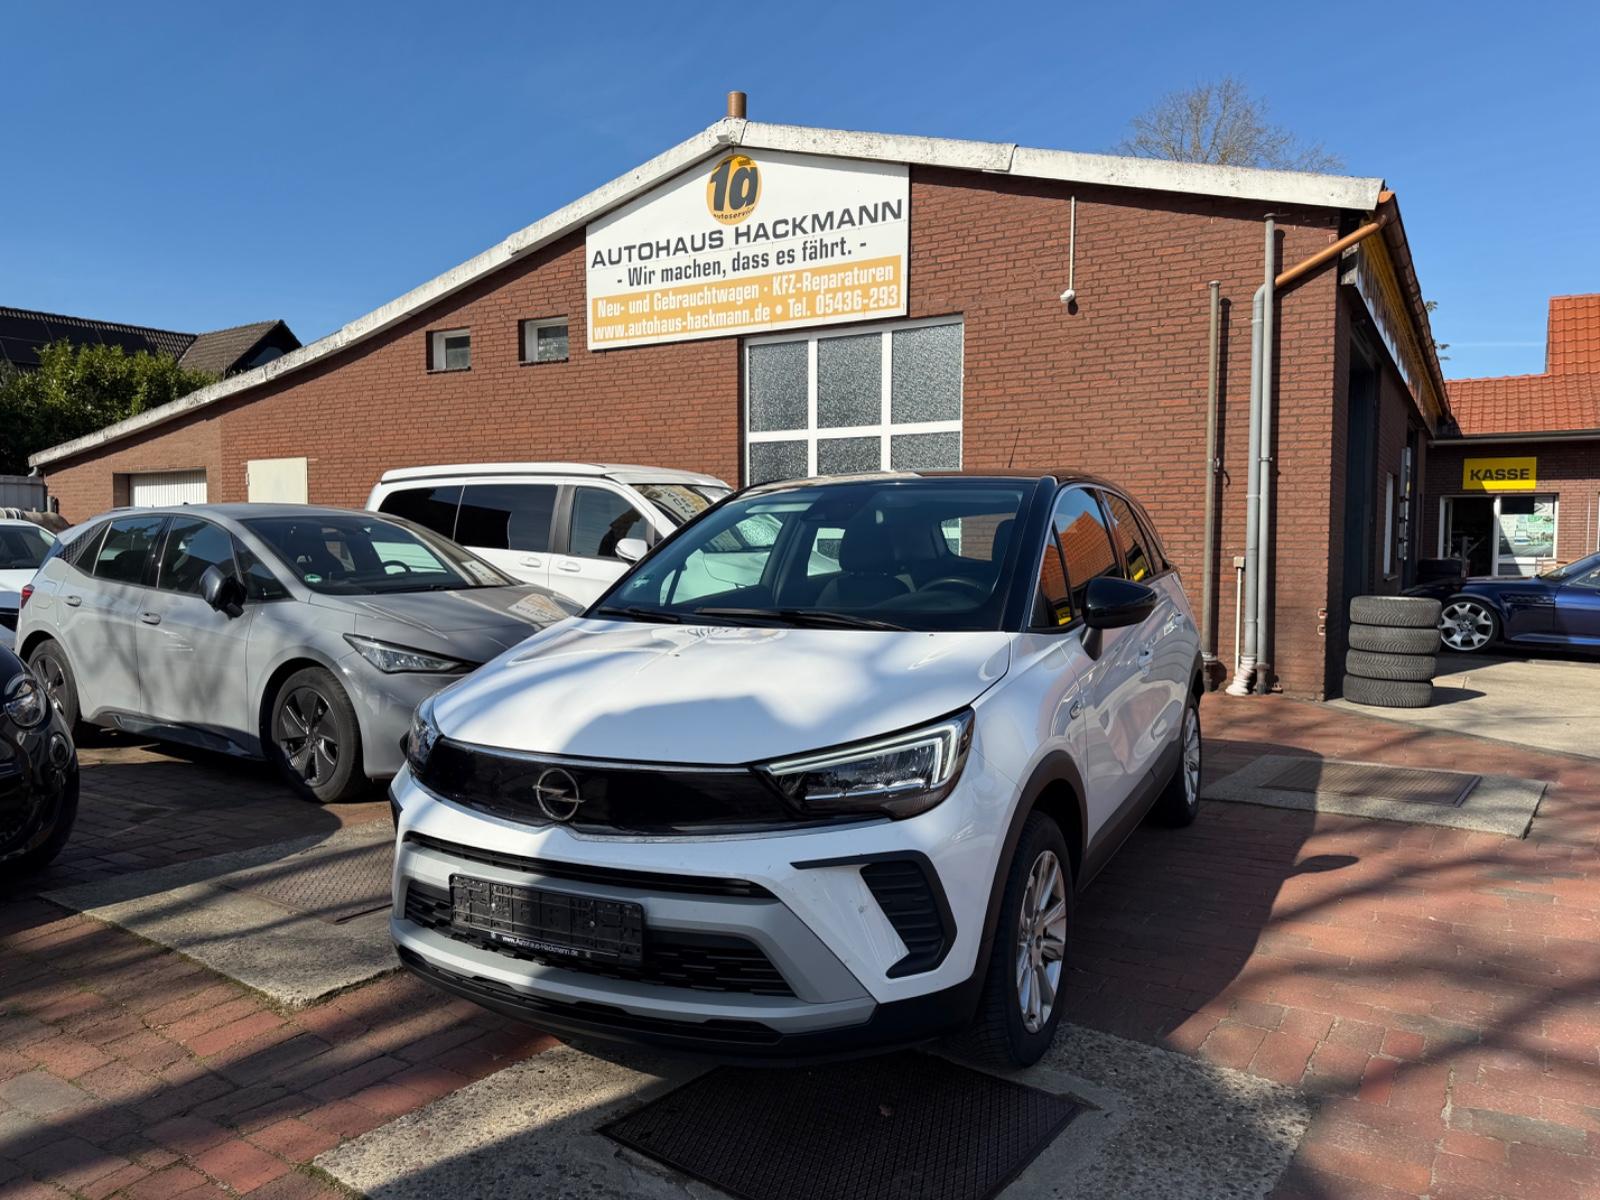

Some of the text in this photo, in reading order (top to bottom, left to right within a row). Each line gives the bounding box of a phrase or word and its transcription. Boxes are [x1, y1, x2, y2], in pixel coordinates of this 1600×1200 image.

[710, 160, 758, 211] 1a
[591, 199, 902, 268] AUTOHAUS HACKMANN
[628, 267, 656, 288] Wir
[661, 257, 727, 283] machen,
[732, 249, 769, 272] dass
[776, 247, 795, 265] es
[802, 237, 852, 262] fährt.
[594, 285, 898, 340] www.autohaus-hackmann.de Tel. 05436-293
[597, 265, 893, 319] Neu- und Gebrauchtwagen KFZ-Reparaturen
[1470, 468, 1530, 481] KASSE
